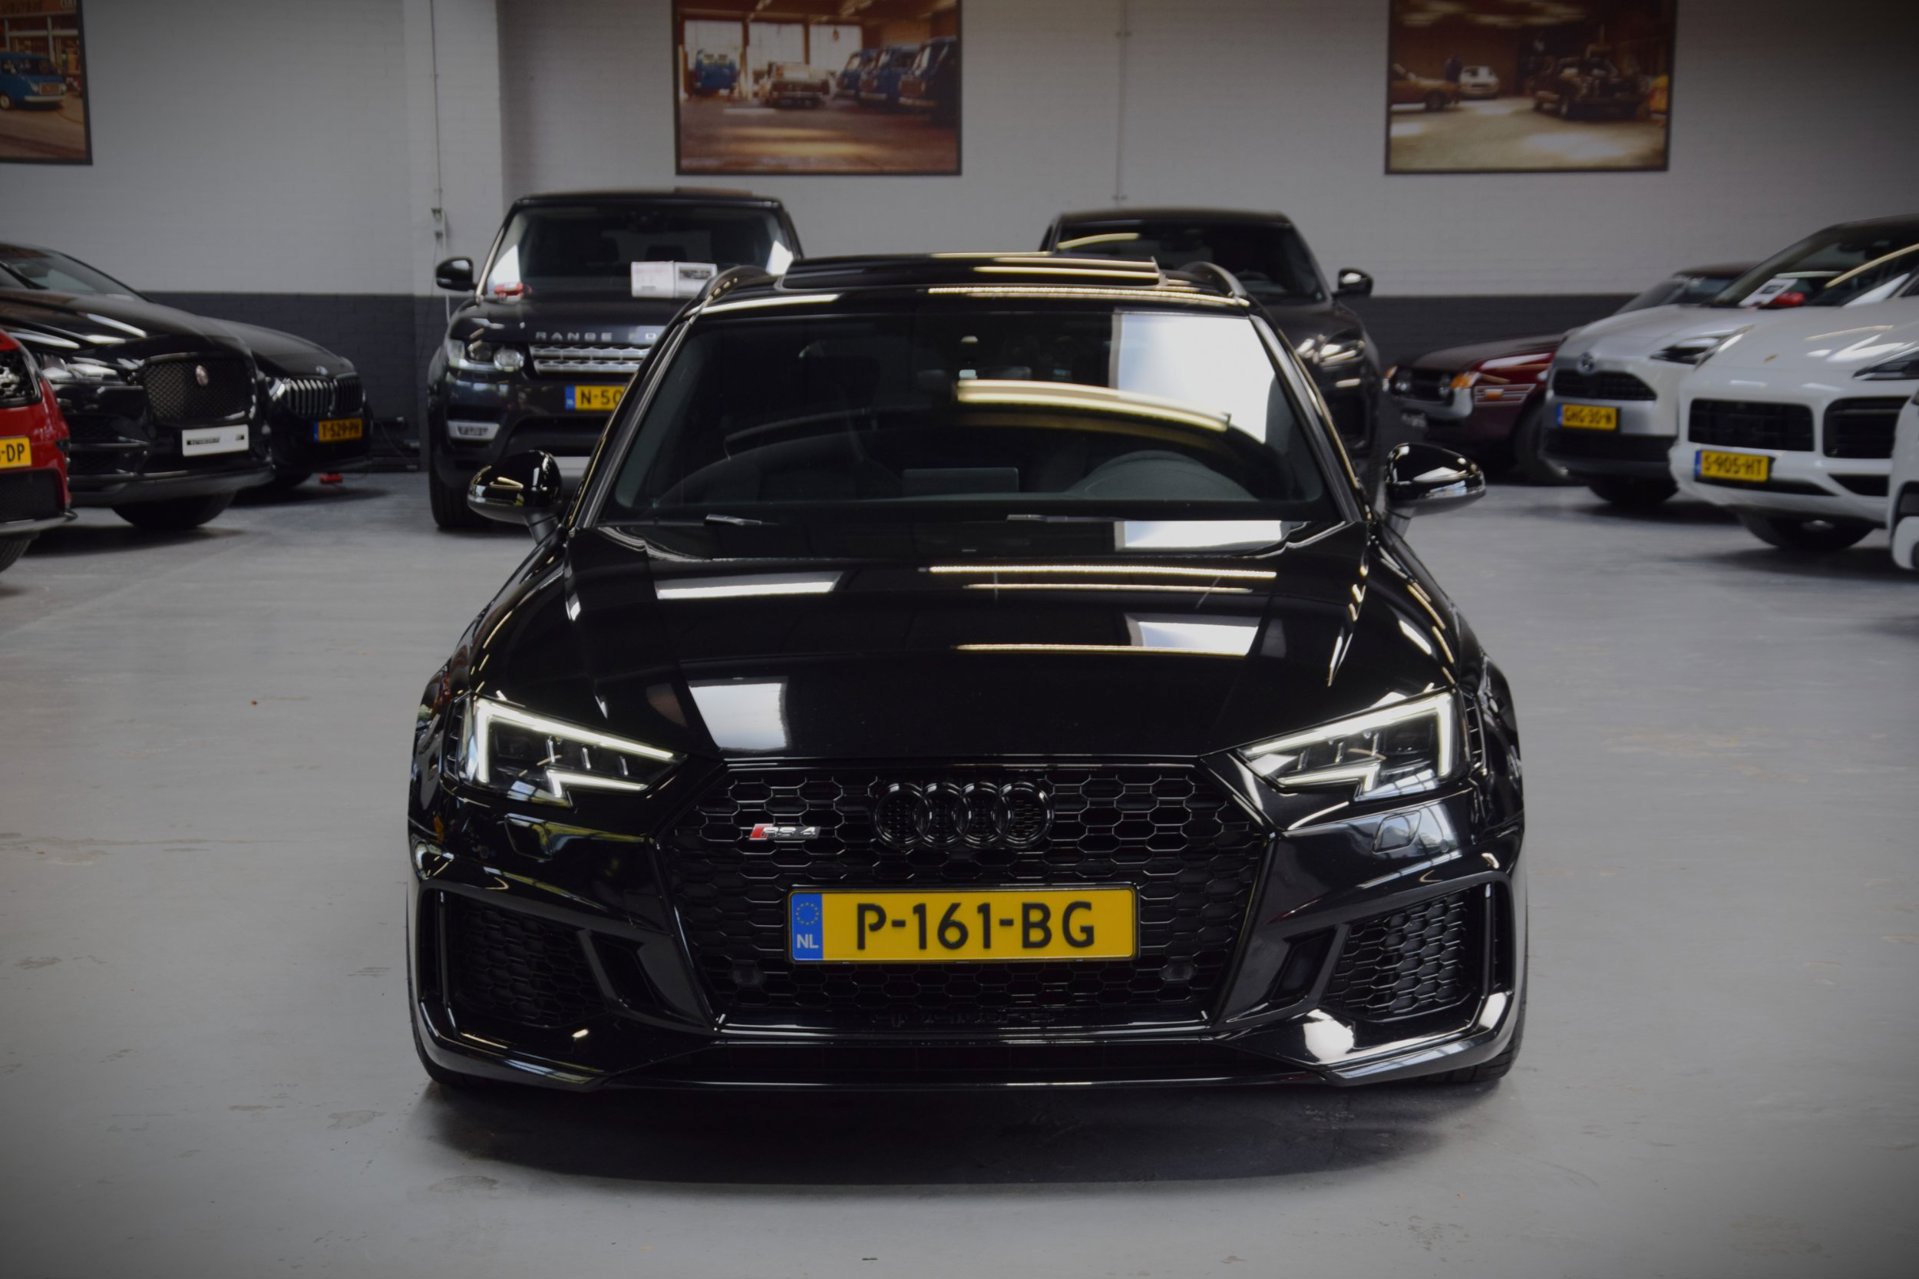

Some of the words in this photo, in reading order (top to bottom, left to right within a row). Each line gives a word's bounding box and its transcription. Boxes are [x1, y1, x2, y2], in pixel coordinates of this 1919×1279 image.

[535, 331, 613, 342] RANGE
[581, 389, 621, 406] N-50
[0, 443, 25, 462] -DP
[856, 901, 1095, 951] P-161-BG
[797, 934, 819, 949] NL
